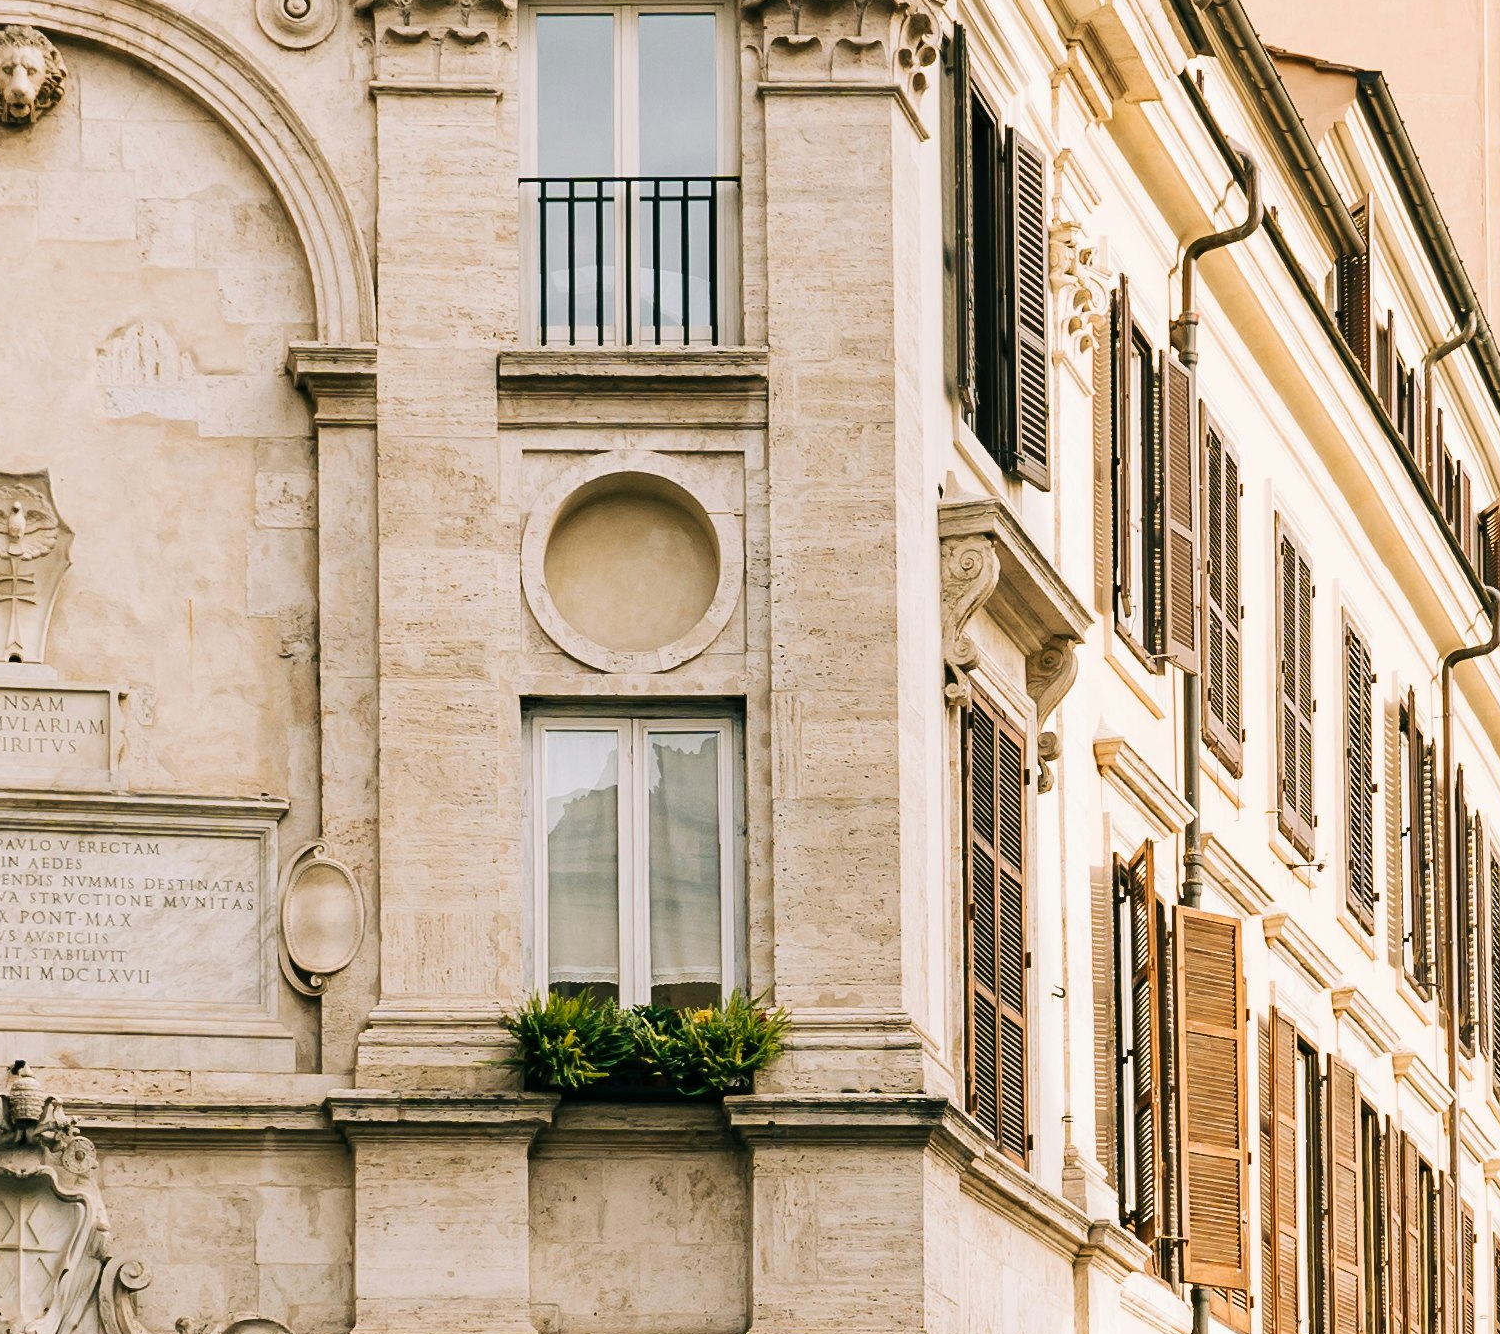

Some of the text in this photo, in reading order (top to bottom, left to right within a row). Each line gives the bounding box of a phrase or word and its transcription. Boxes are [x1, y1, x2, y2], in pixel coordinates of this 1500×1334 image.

[59, 840, 70, 852] V
[77, 841, 161, 856] ERECTAM
[1, 855, 19, 868] IN
[28, 857, 83, 870] AEDES
[62, 874, 135, 890] NVMMIS
[144, 877, 255, 893] DESTINATAS
[29, 891, 153, 908] STRVCTIONE
[163, 896, 255, 911] MVNITAS
[24, 930, 110, 944] AVSPICIIS
[31, 947, 128, 963] STABILIVIT
[97, 969, 151, 985] LXVII
